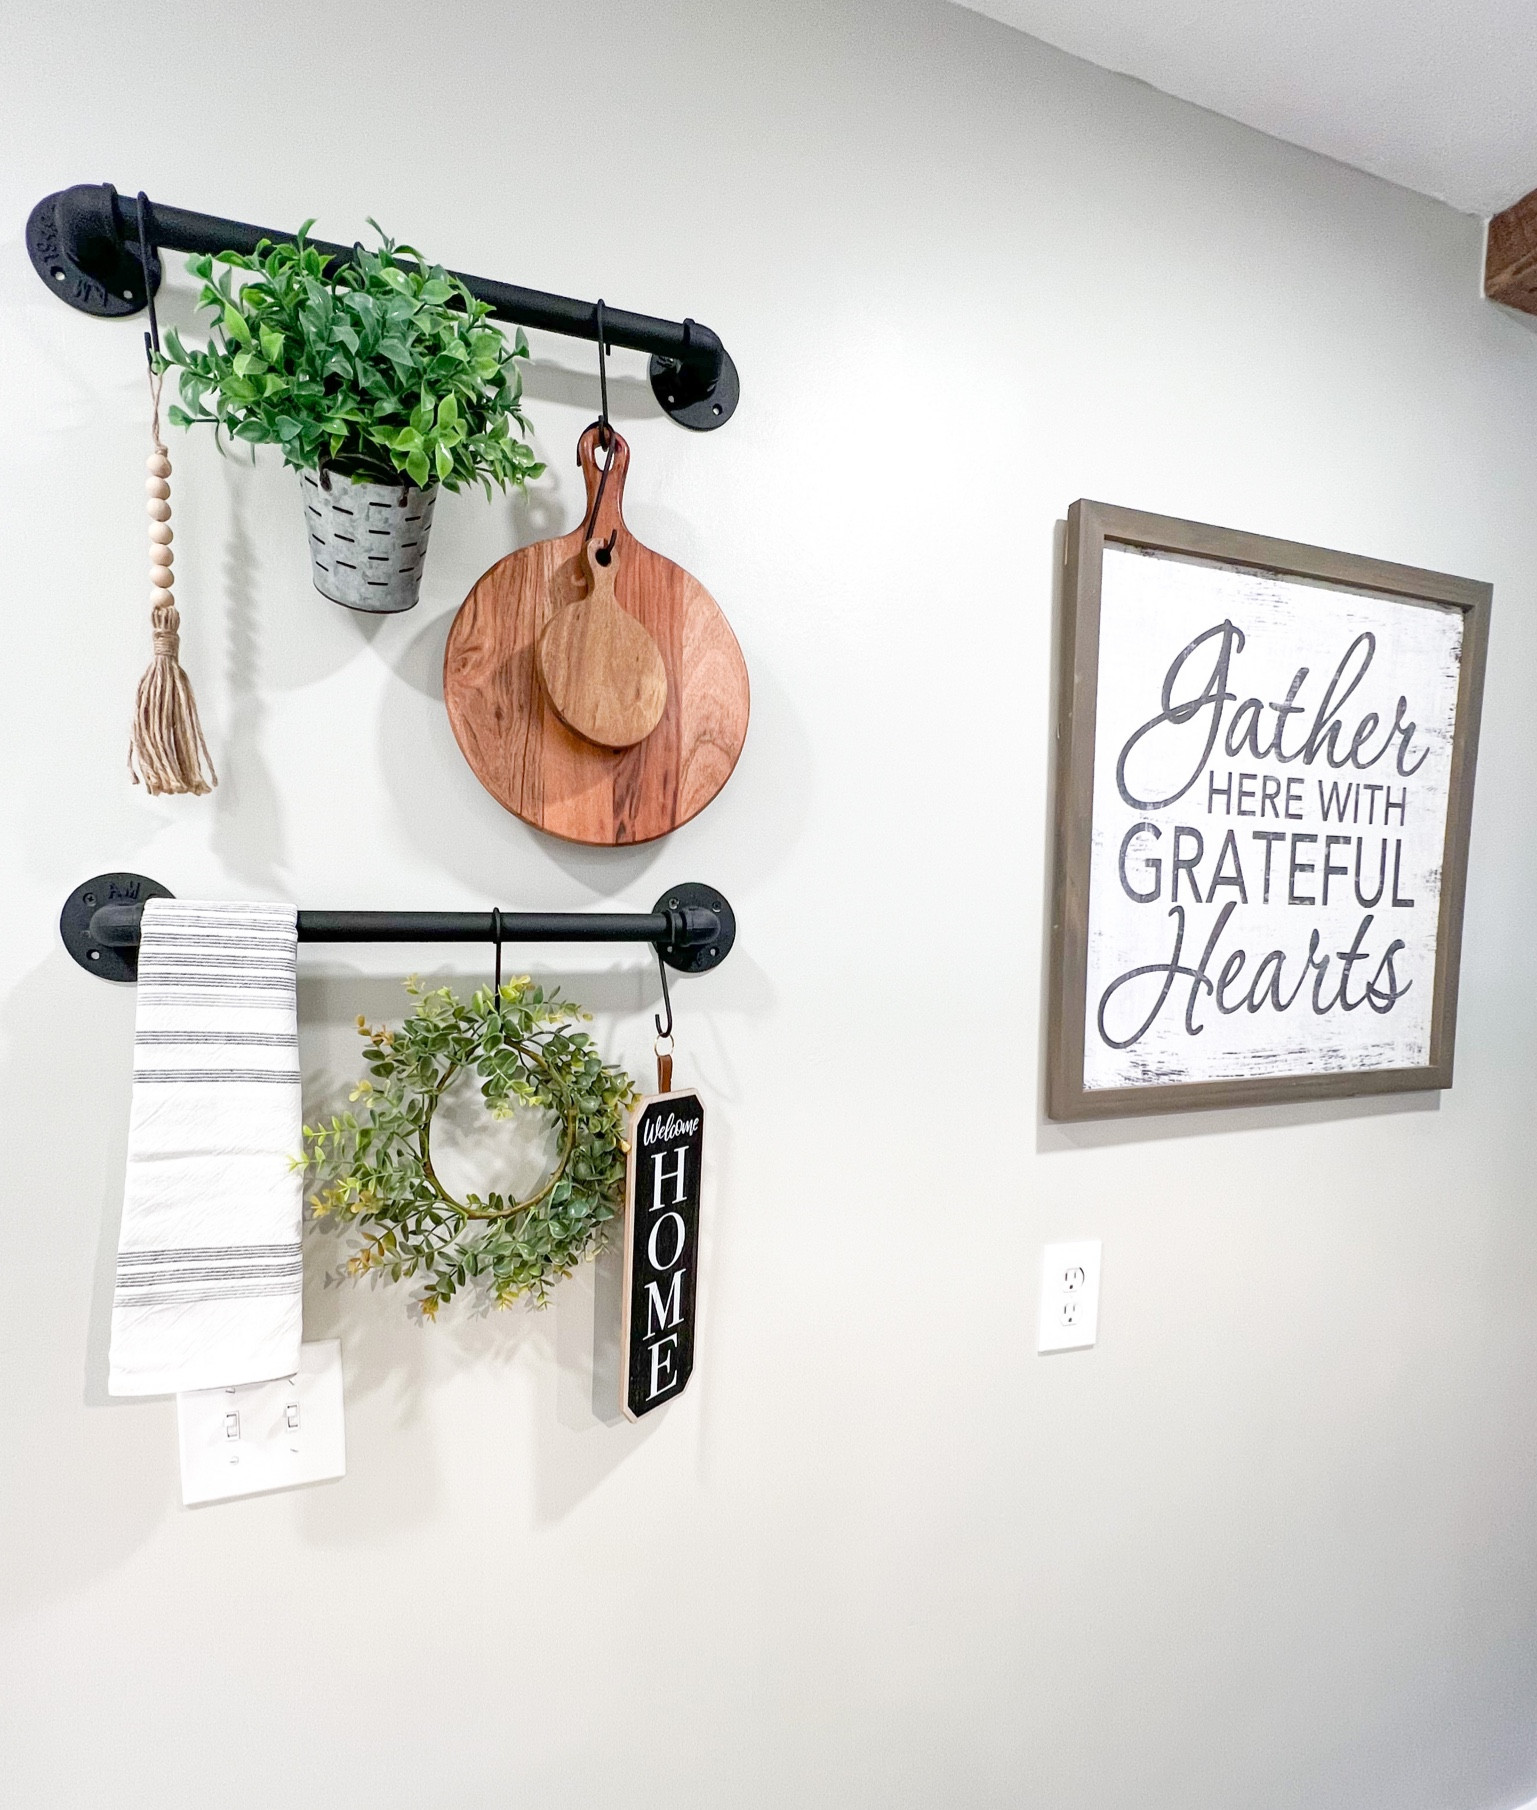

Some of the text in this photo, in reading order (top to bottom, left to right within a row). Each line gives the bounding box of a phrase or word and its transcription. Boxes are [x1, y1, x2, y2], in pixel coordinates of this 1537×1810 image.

[1116, 619, 1430, 811] Gather
[1207, 771, 1407, 827] HERE WITH
[1119, 822, 1415, 909] GRATEFUL
[1097, 901, 1413, 1050] Hearts
[643, 1112, 700, 1147] Welcome
[642, 1145, 690, 1402] HOME
